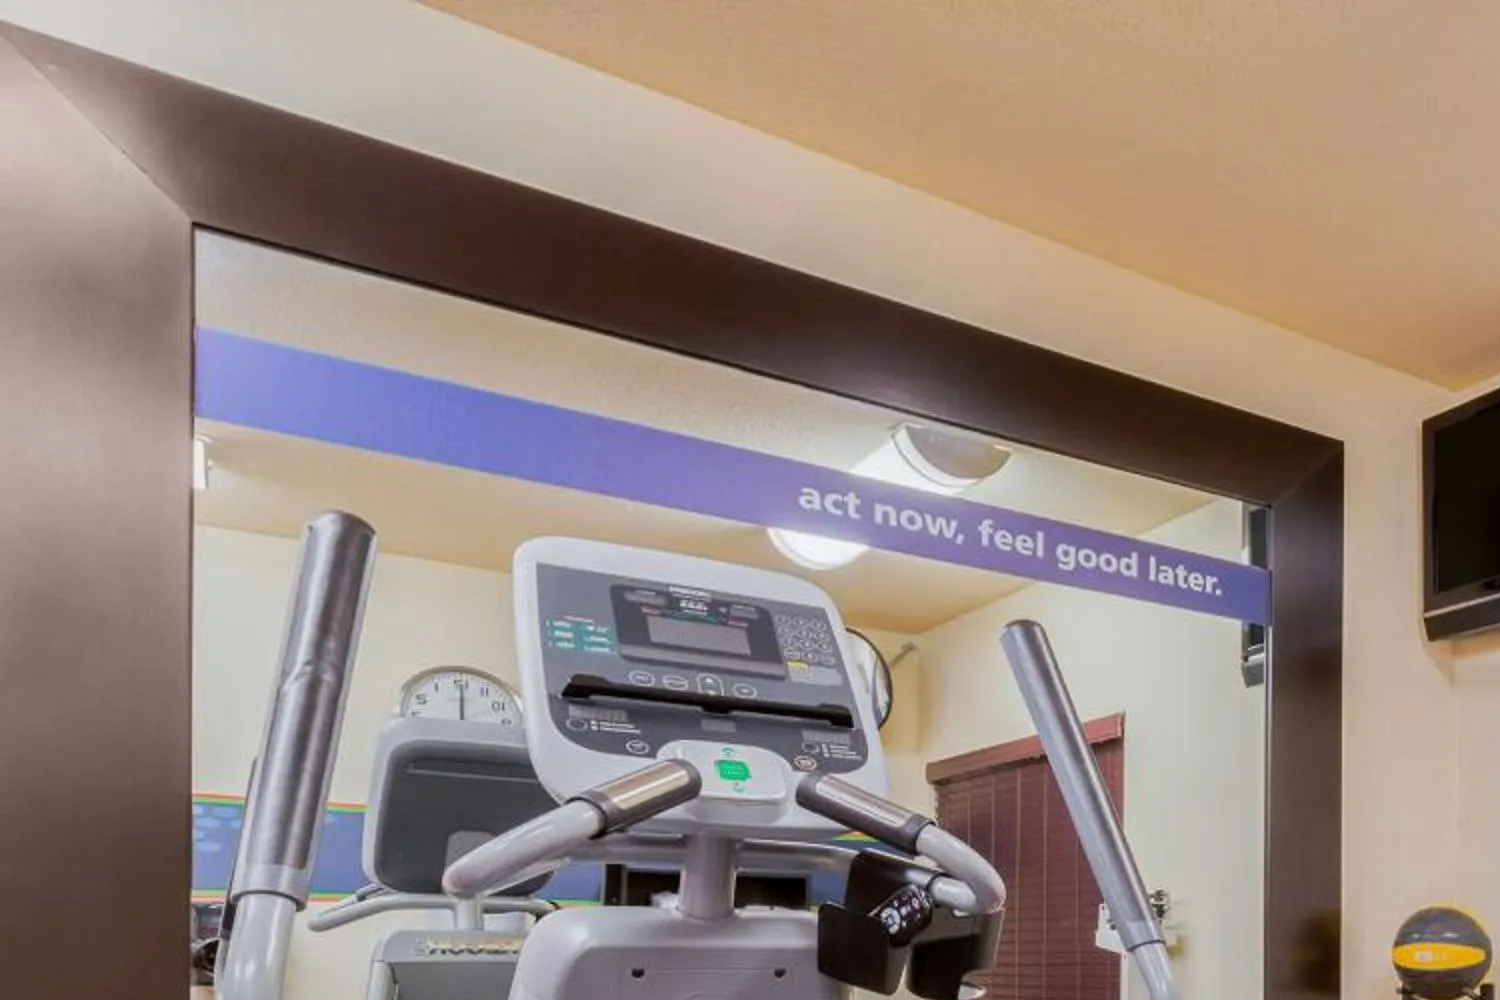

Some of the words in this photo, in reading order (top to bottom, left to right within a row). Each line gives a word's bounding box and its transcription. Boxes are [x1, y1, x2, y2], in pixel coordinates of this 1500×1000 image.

[799, 486, 863, 520] act
[873, 501, 966, 545] now,
[977, 518, 1046, 560] feel
[1055, 542, 1140, 579] good
[1149, 554, 1224, 597] later.
